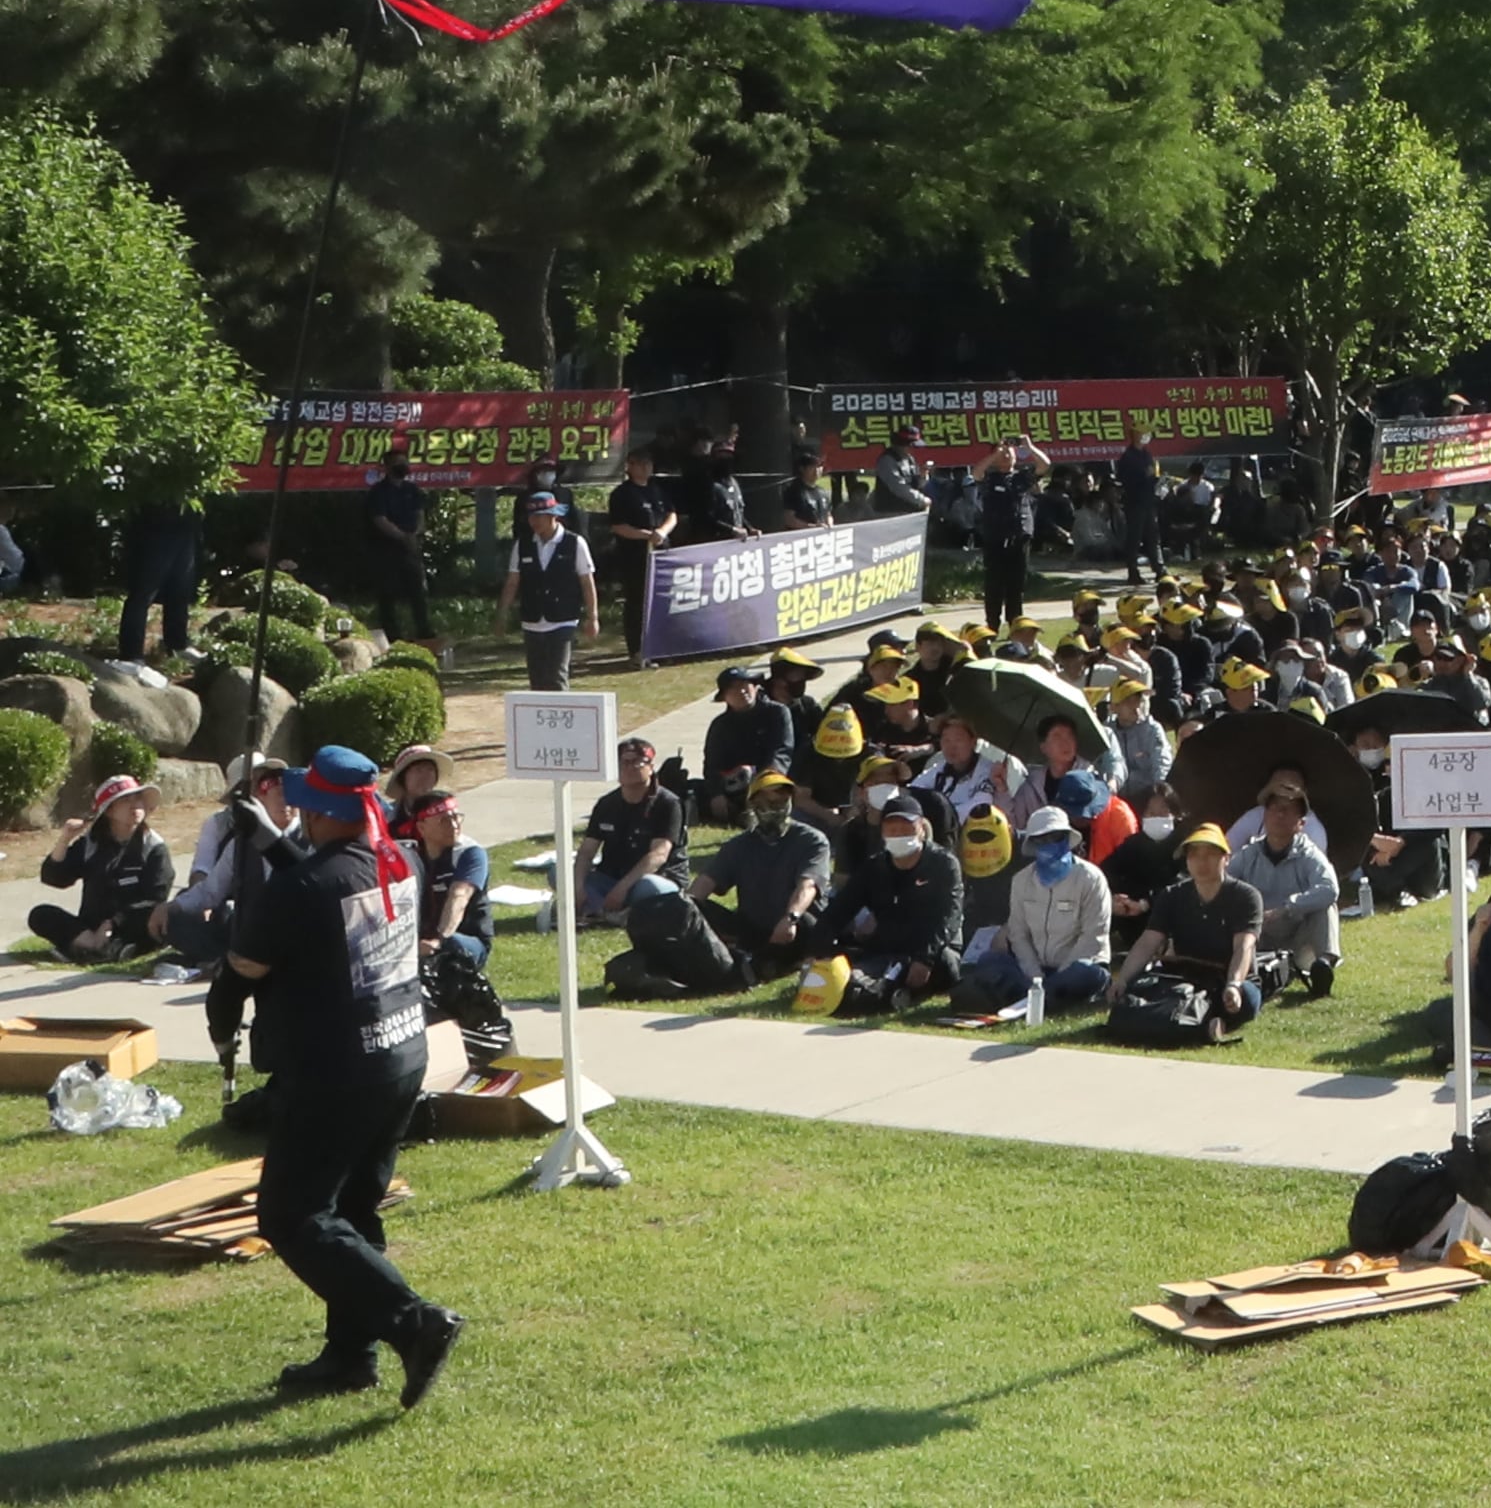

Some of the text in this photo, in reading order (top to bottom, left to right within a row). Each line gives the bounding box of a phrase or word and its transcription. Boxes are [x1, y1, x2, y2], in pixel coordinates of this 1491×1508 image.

[352, 400, 422, 422] 완전승리!!
[832, 389, 1058, 411] 2026년 단체교섭 완전승리!!
[921, 413, 971, 447] 관련
[975, 412, 1022, 443] 대책
[1027, 411, 1052, 442] 및
[1056, 409, 1124, 441] 퇴직금
[1177, 407, 1221, 437] 방안
[1224, 406, 1273, 437] 마련!
[405, 427, 499, 465] 고용안정
[558, 425, 610, 461] 요구!
[769, 528, 854, 589] 총단결로
[776, 551, 920, 637] 원청교섭 쟁취하자!
[536, 709, 574, 729] 5공장
[533, 747, 580, 767] 사업부
[1428, 751, 1478, 772] 4공장
[1425, 792, 1483, 813] 사업부
